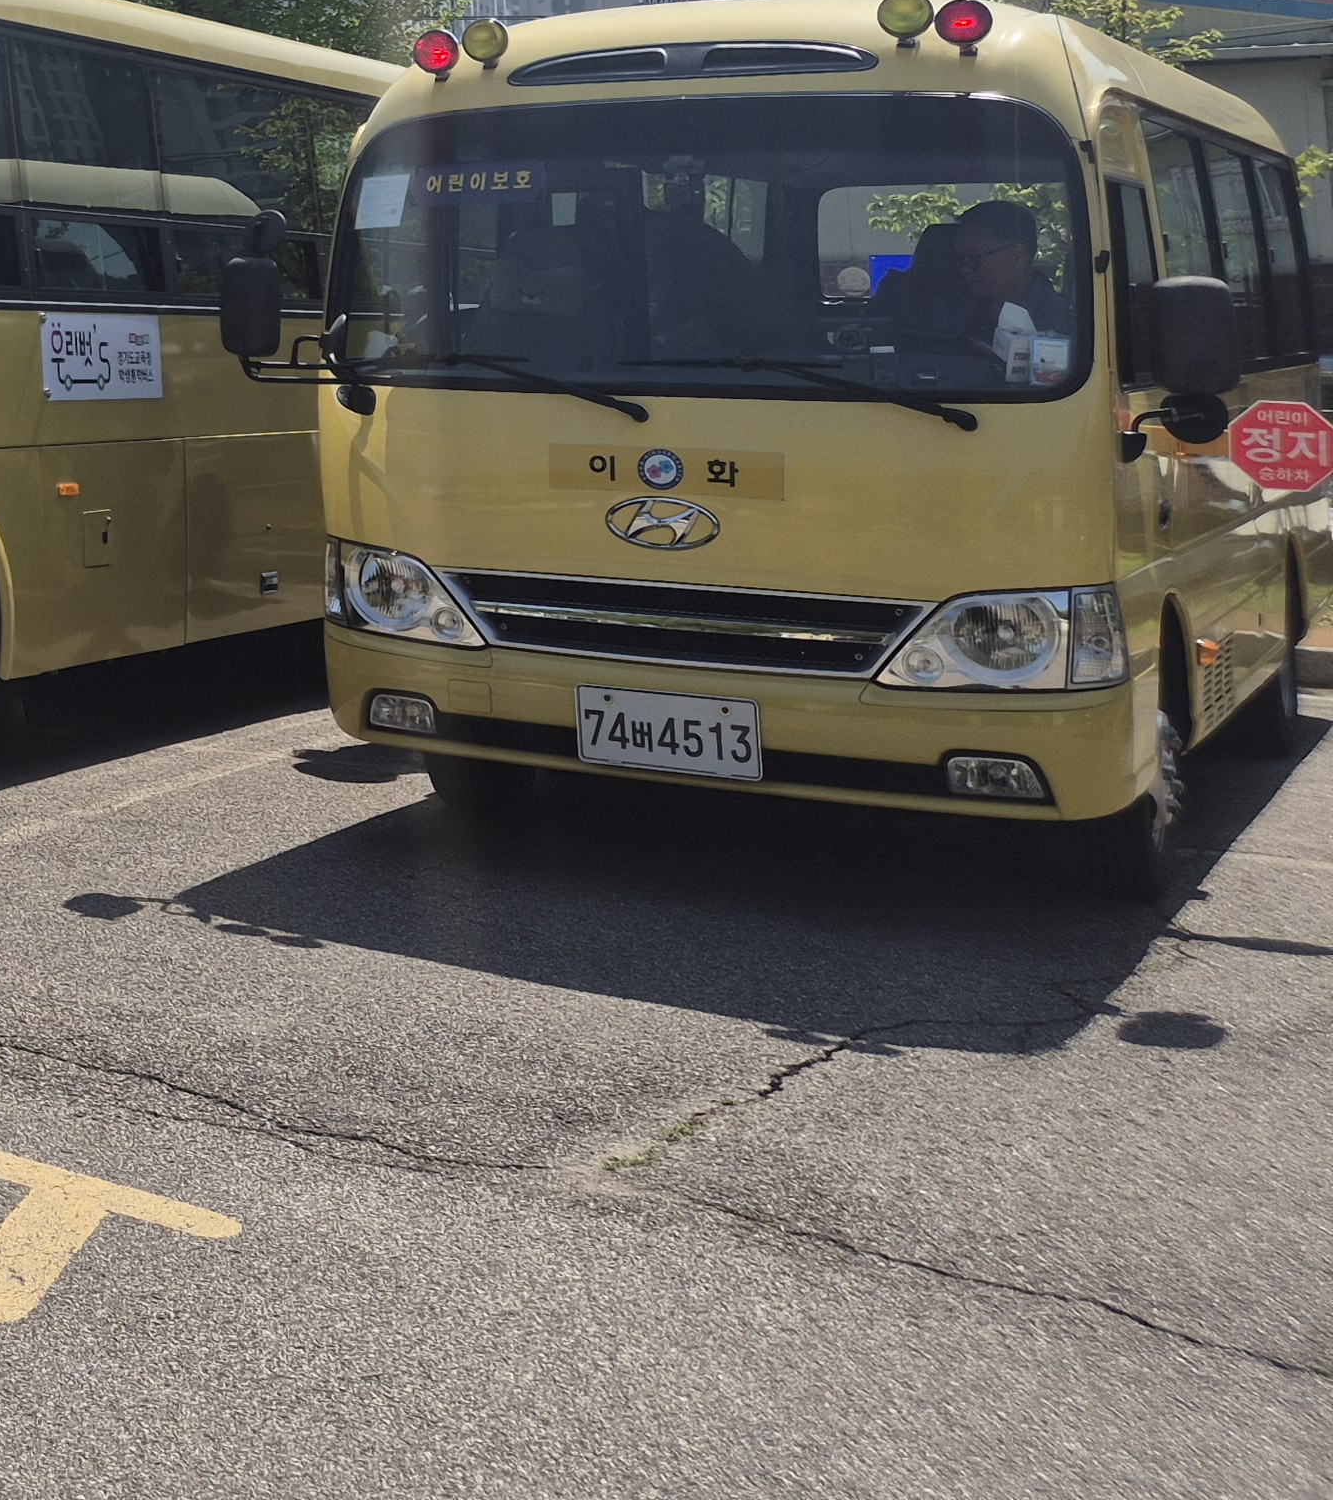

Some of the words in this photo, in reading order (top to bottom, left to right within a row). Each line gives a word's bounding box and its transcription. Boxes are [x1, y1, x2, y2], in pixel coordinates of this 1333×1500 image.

[426, 170, 532, 194] 어린이보호
[1257, 409, 1308, 426] 어린이
[1241, 427, 1327, 467] 정지
[589, 455, 616, 482] 이
[706, 459, 739, 488] 화
[1258, 466, 1311, 483] 승하차
[584, 708, 753, 764] 74버4513
